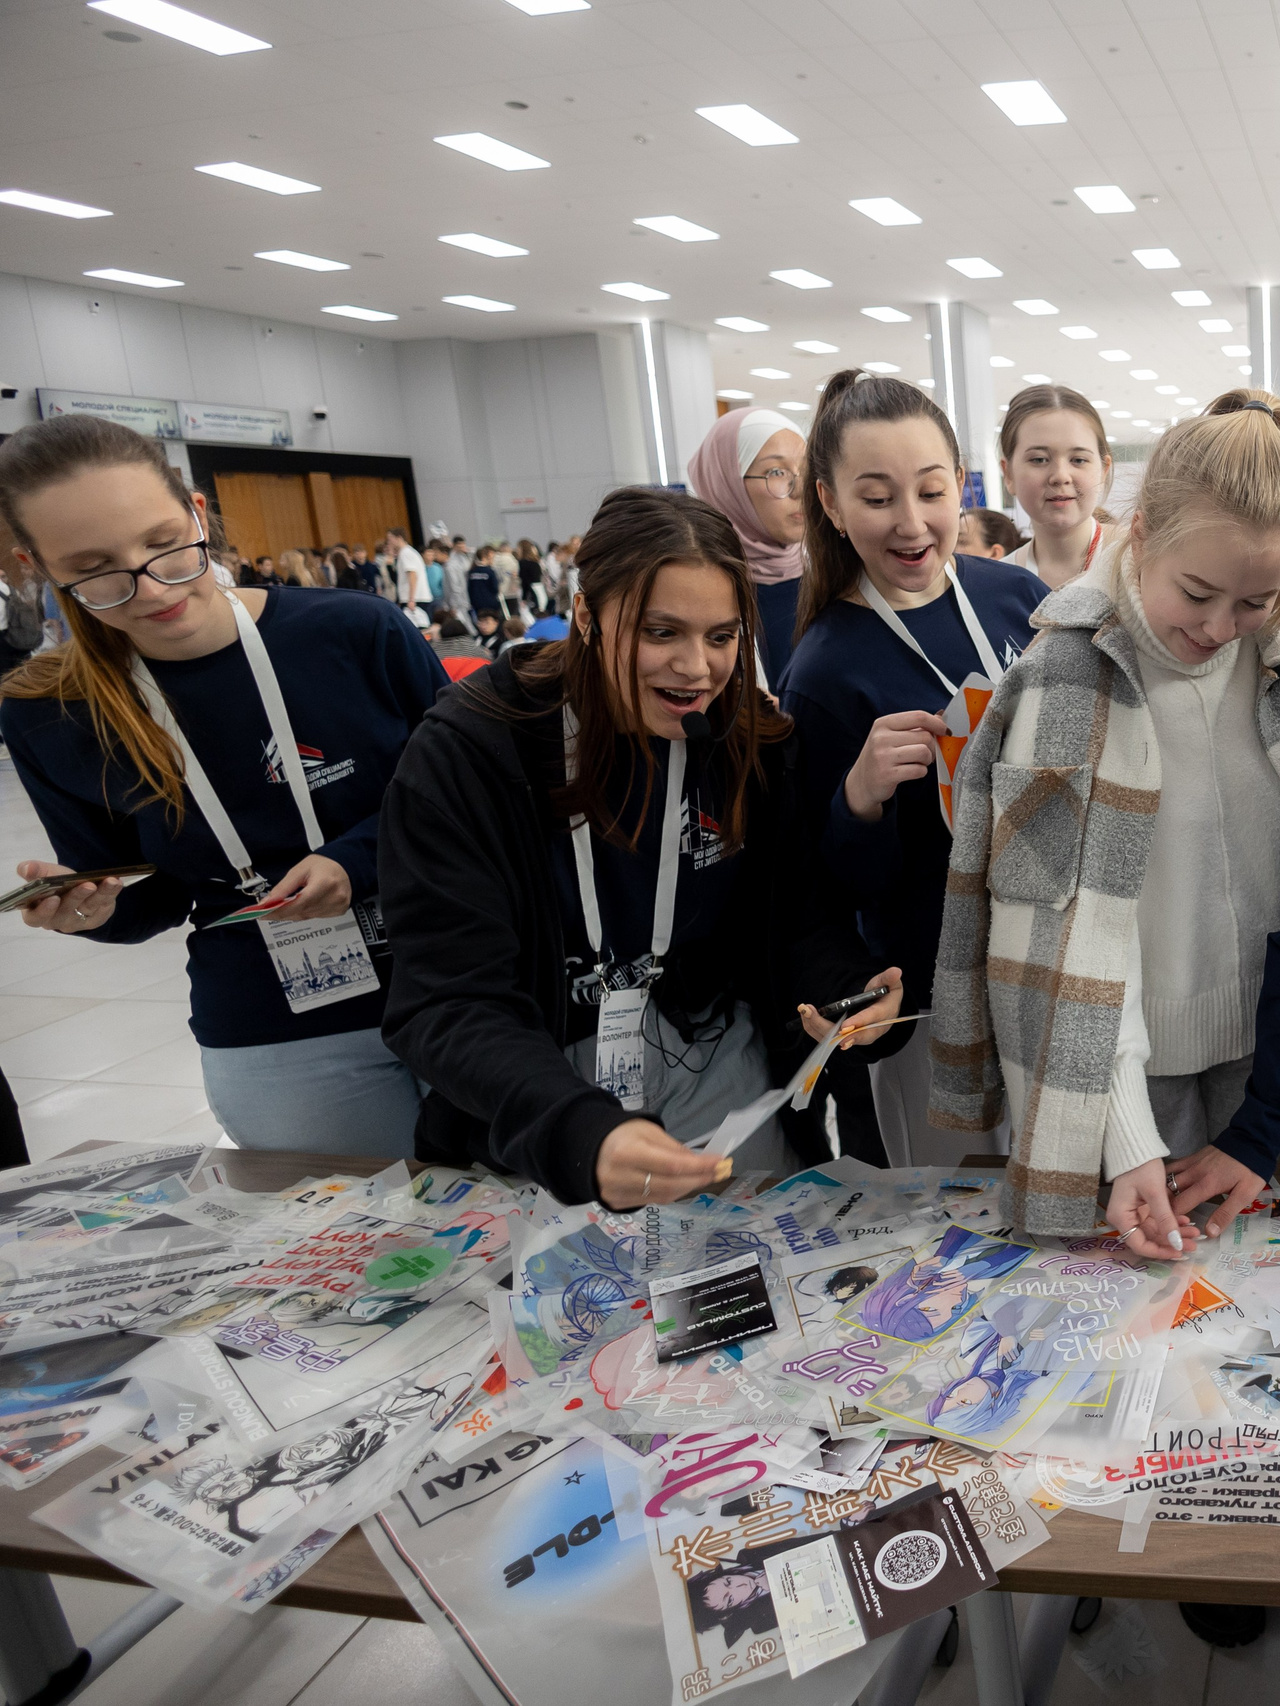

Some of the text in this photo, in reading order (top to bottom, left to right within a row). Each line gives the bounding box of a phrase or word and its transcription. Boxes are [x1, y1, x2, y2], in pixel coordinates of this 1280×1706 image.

[71, 400, 115, 412] МОЛОДОЙ
[116, 403, 168, 415] СПЕЦИАЛИСТ
[203, 411, 238, 421] МОЛОДОЙ
[308, 778, 328, 791] ИТЕЛЬ
[276, 926, 333, 948] ВОЛОНТЕР
[602, 1031, 632, 1043] ВОЛОНТЕР
[833, 1191, 864, 1221] ЛЕНО
[308, 1228, 377, 1244] КРУТ
[640, 1205, 662, 1276] Утро доброе
[285, 1243, 351, 1258] КРУТ
[191, 1259, 266, 1280] ГОРЫ
[260, 1256, 325, 1271] КРУТ
[147, 1273, 187, 1289] ПО
[232, 1270, 298, 1287] КРУТ
[1000, 1275, 1140, 1297] СЧАСТЛИВ
[32, 1283, 143, 1315] КОЛЕНО
[1066, 1295, 1121, 1314] КТО
[686, 1301, 767, 1331] CUSTOMLAB
[1059, 1313, 1118, 1335] ТОТ,
[671, 1322, 773, 1357] ПРИНТЕРИЯ
[1052, 1332, 1143, 1362] ПРАВ
[708, 1354, 774, 1411] ГОРЫ ПО
[196, 1350, 270, 1443] BUNGOU STRAY
[1225, 1391, 1269, 1418] КОЛЕНО
[0, 1405, 102, 1434] INOSUK
[89, 1421, 221, 1494] VINLAN
[420, 1457, 503, 1501] KAI
[1122, 1460, 1248, 1495] СУЕТОЛОГ
[1157, 1497, 1258, 1511] лукавого
[1154, 1510, 1194, 1523] это
[948, 1503, 987, 1582] CUSTOMLAB.GROUP
[852, 1539, 884, 1619] КАК НАС НАЙТИ:
